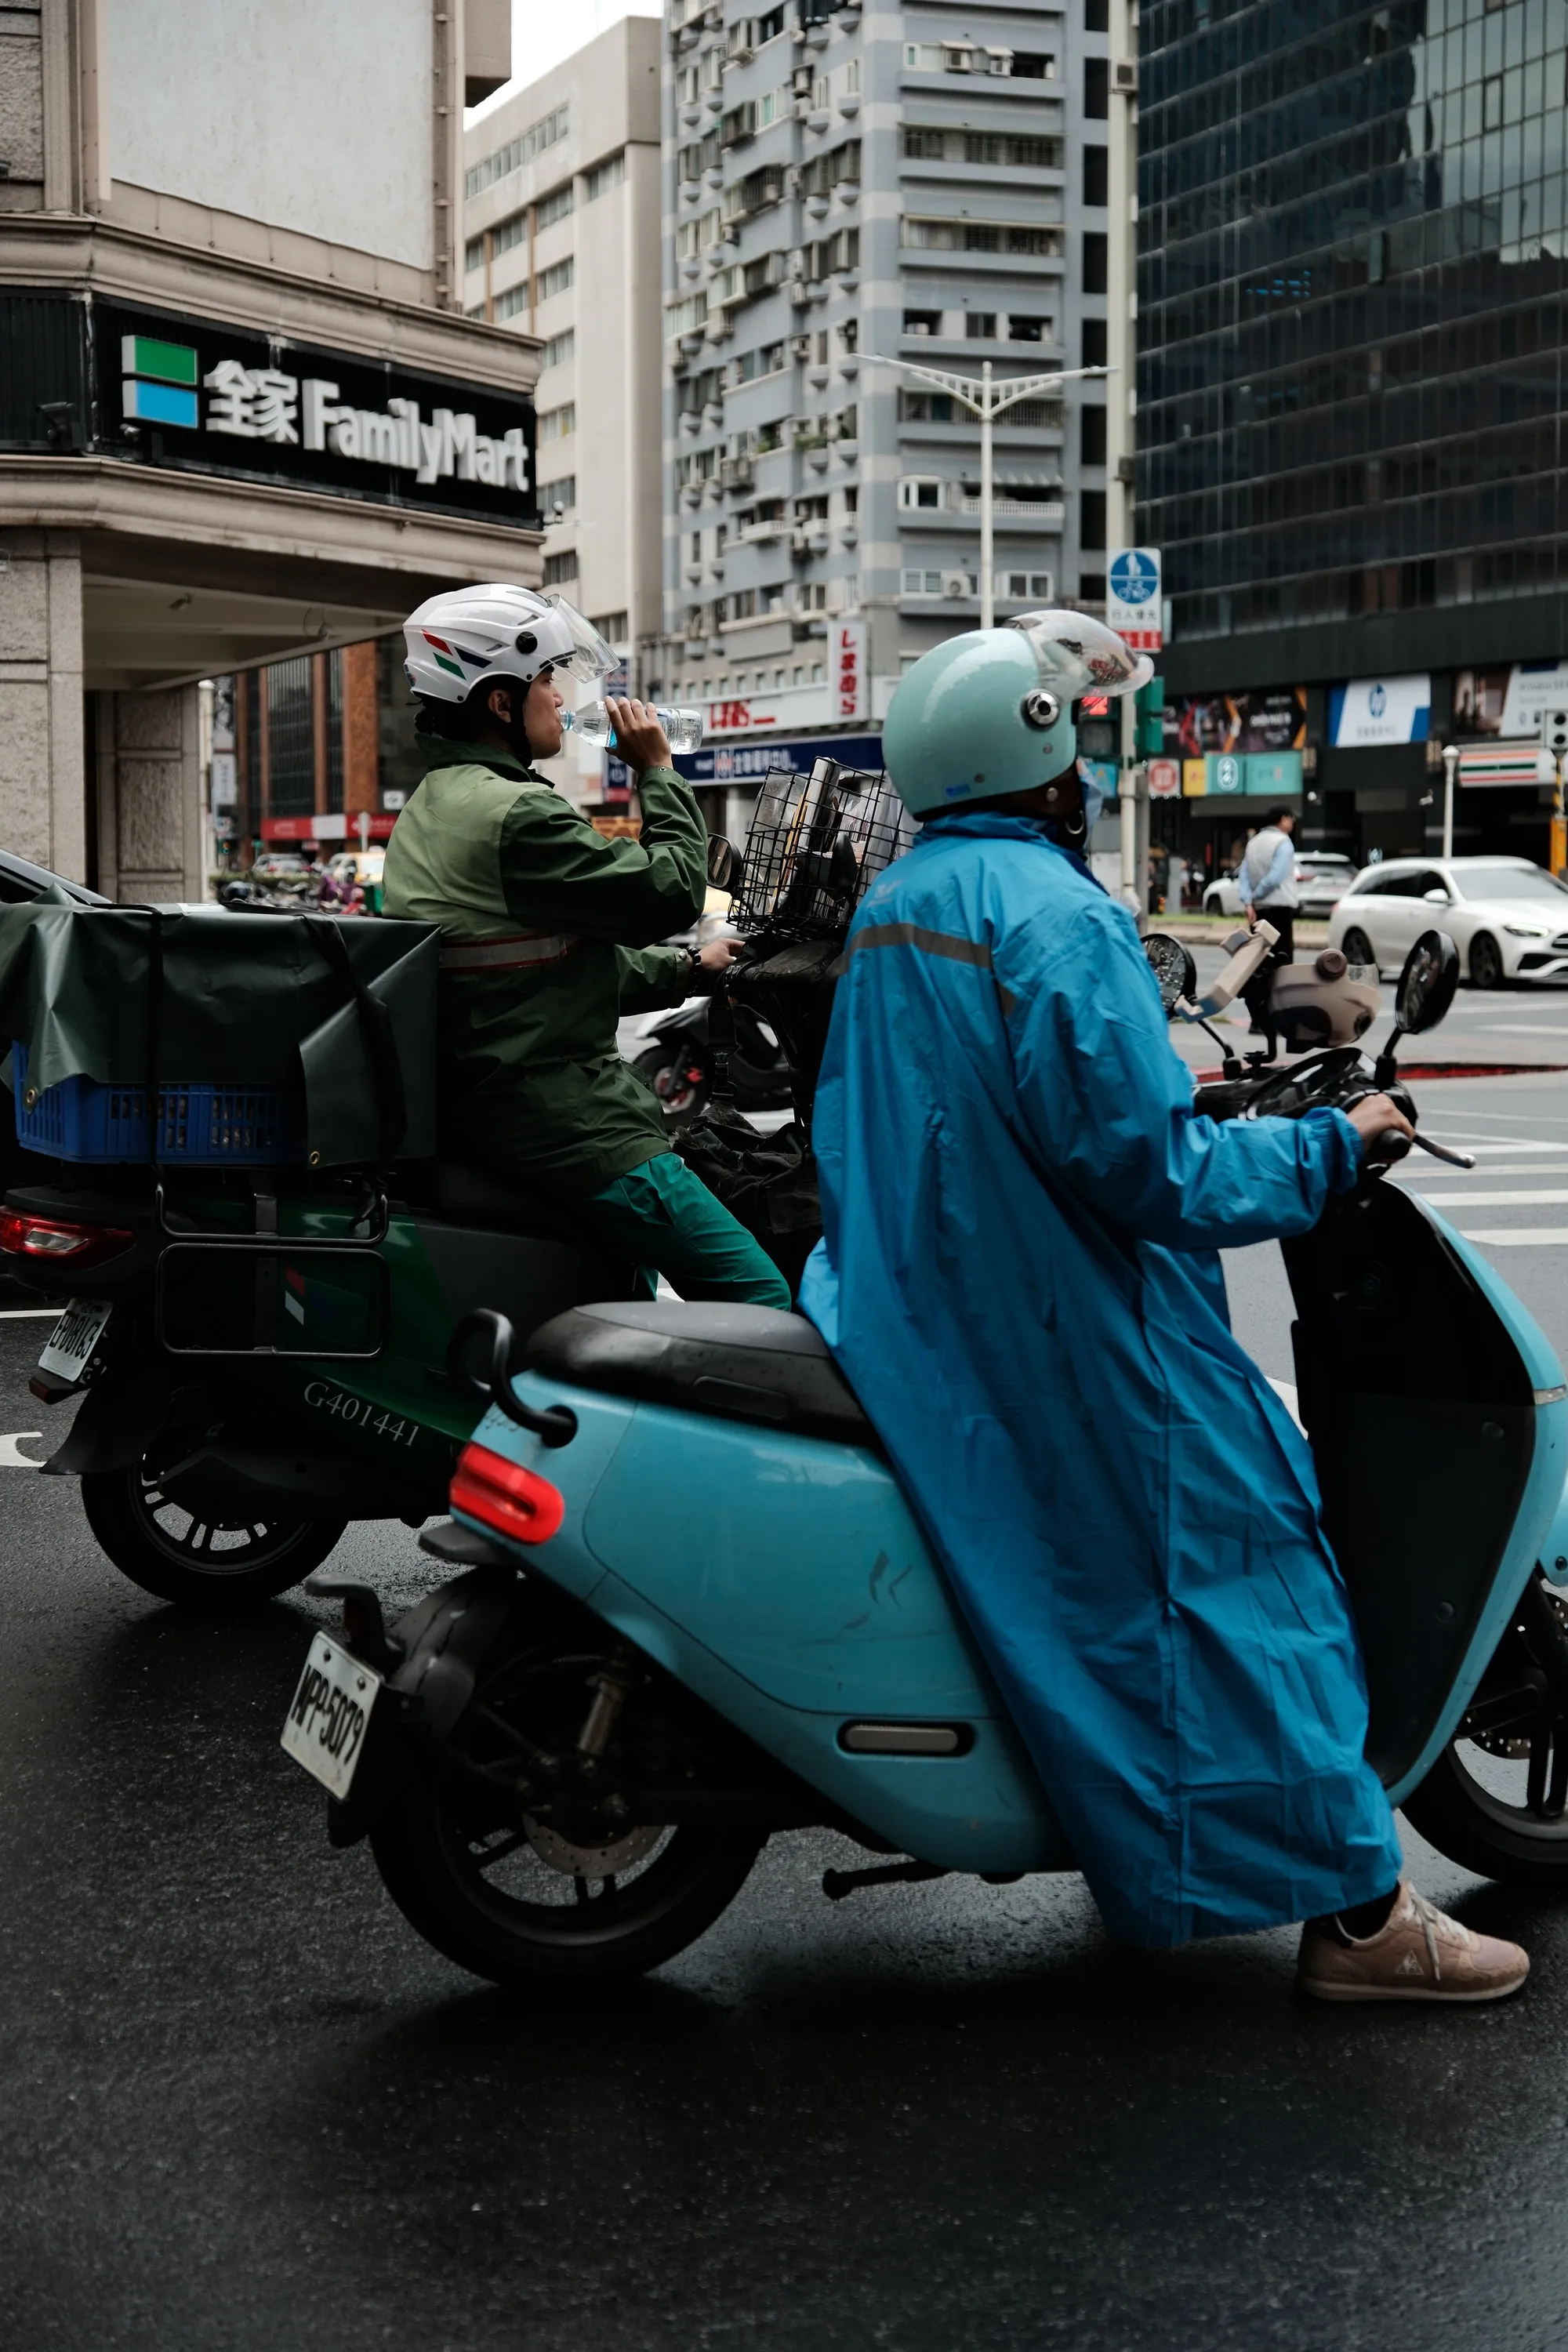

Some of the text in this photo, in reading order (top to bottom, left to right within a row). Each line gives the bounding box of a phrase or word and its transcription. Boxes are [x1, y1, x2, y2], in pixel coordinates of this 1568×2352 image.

[205, 360, 530, 493] 全家 FamilyMart
[303, 1381, 419, 1447] G401441
